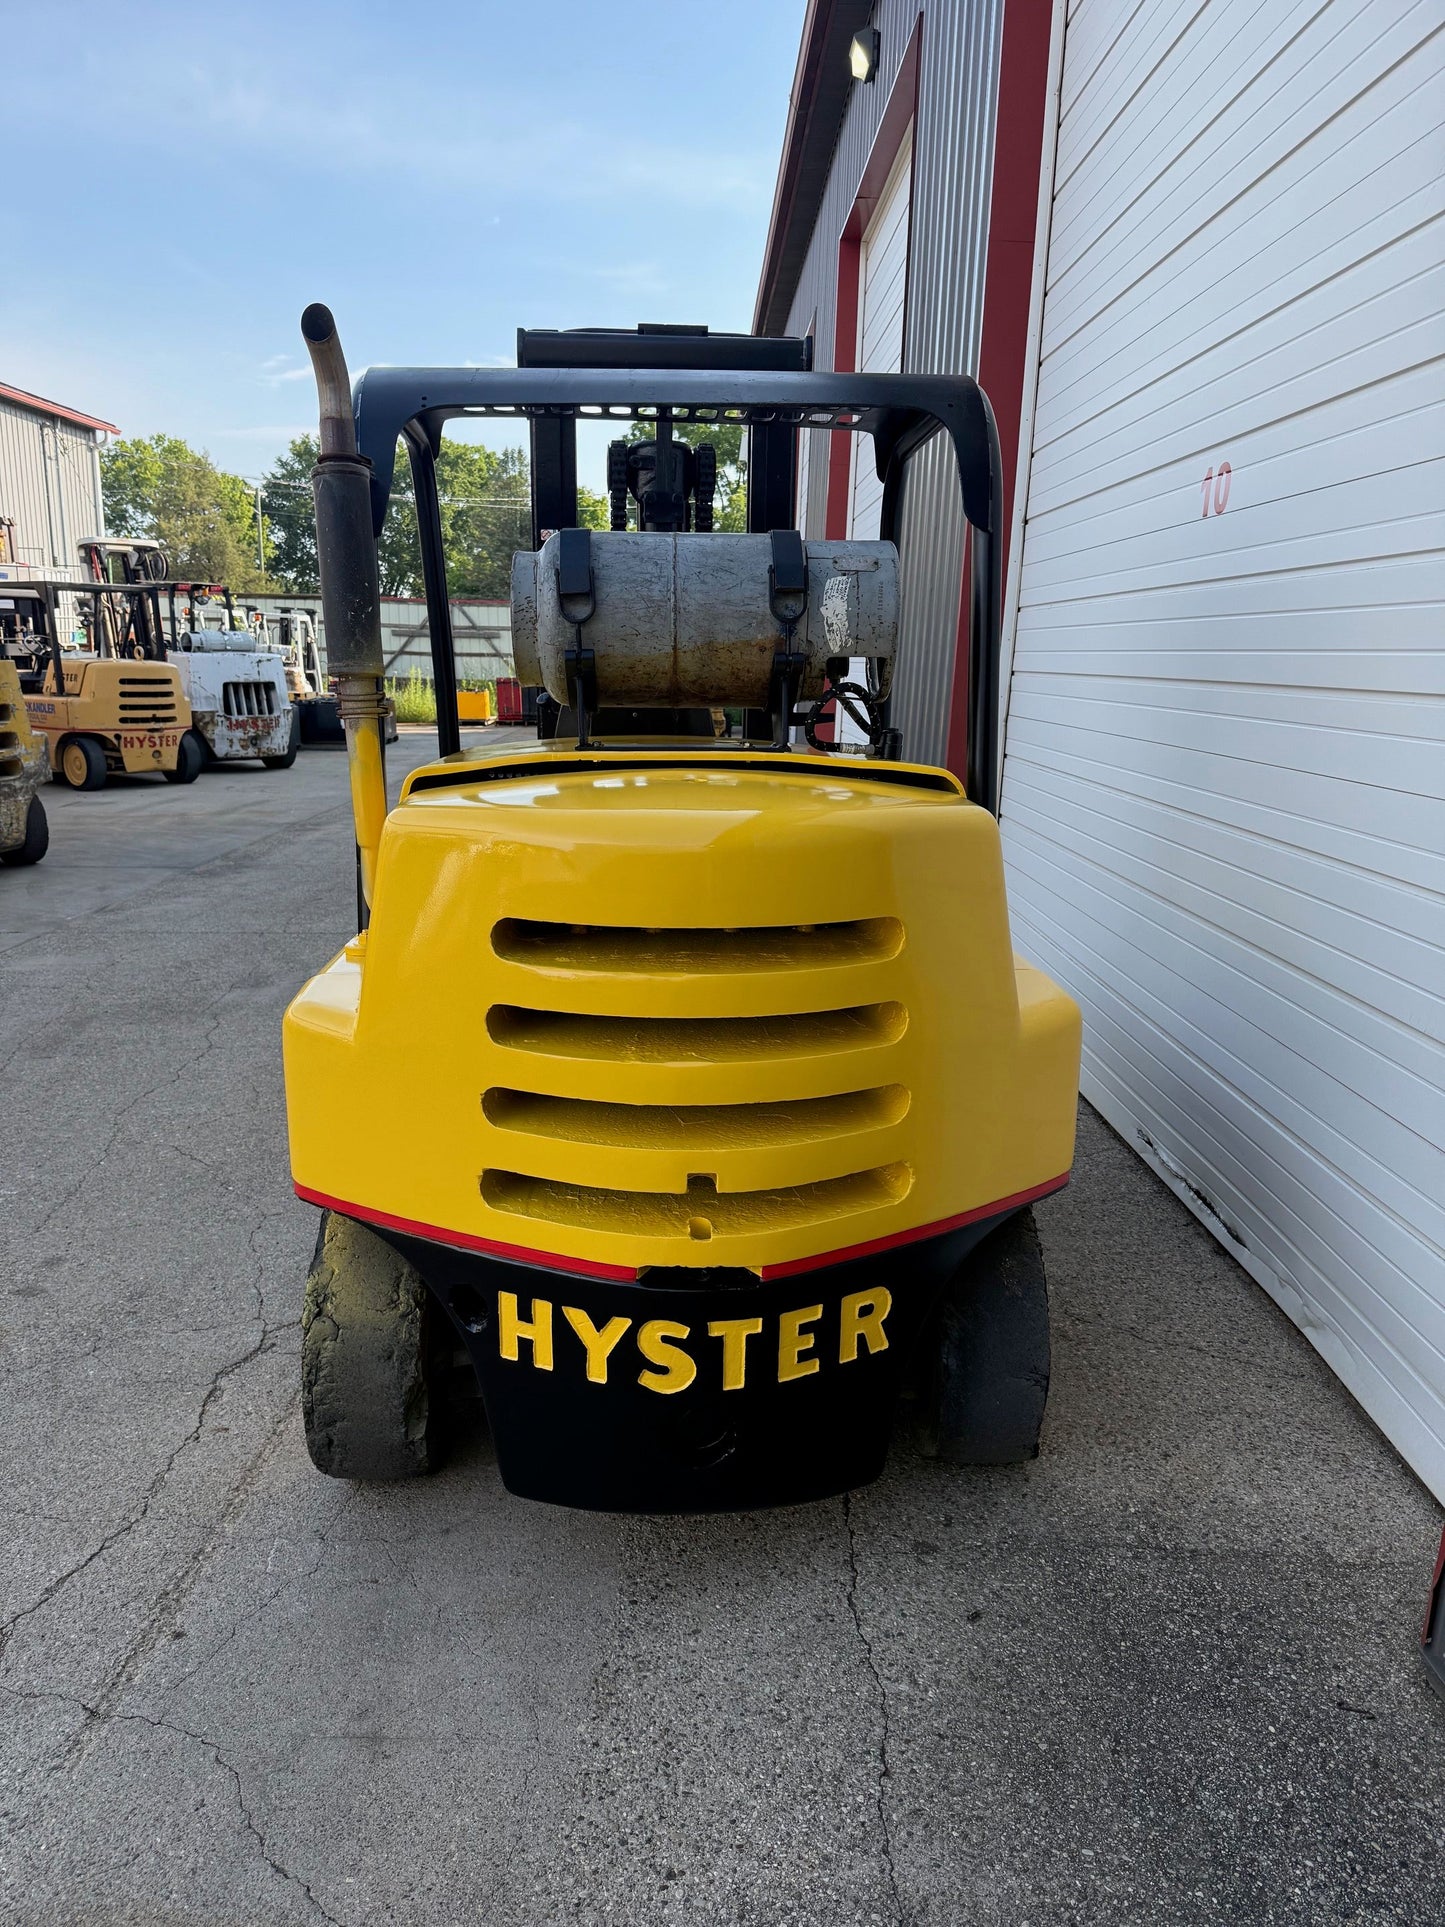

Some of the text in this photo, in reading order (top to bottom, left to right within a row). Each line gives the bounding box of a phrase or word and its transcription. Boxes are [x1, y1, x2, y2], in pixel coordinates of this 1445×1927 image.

[1201, 461, 1231, 517] 10
[123, 735, 178, 748] HYSTER
[498, 1286, 892, 1394] HYSTER
